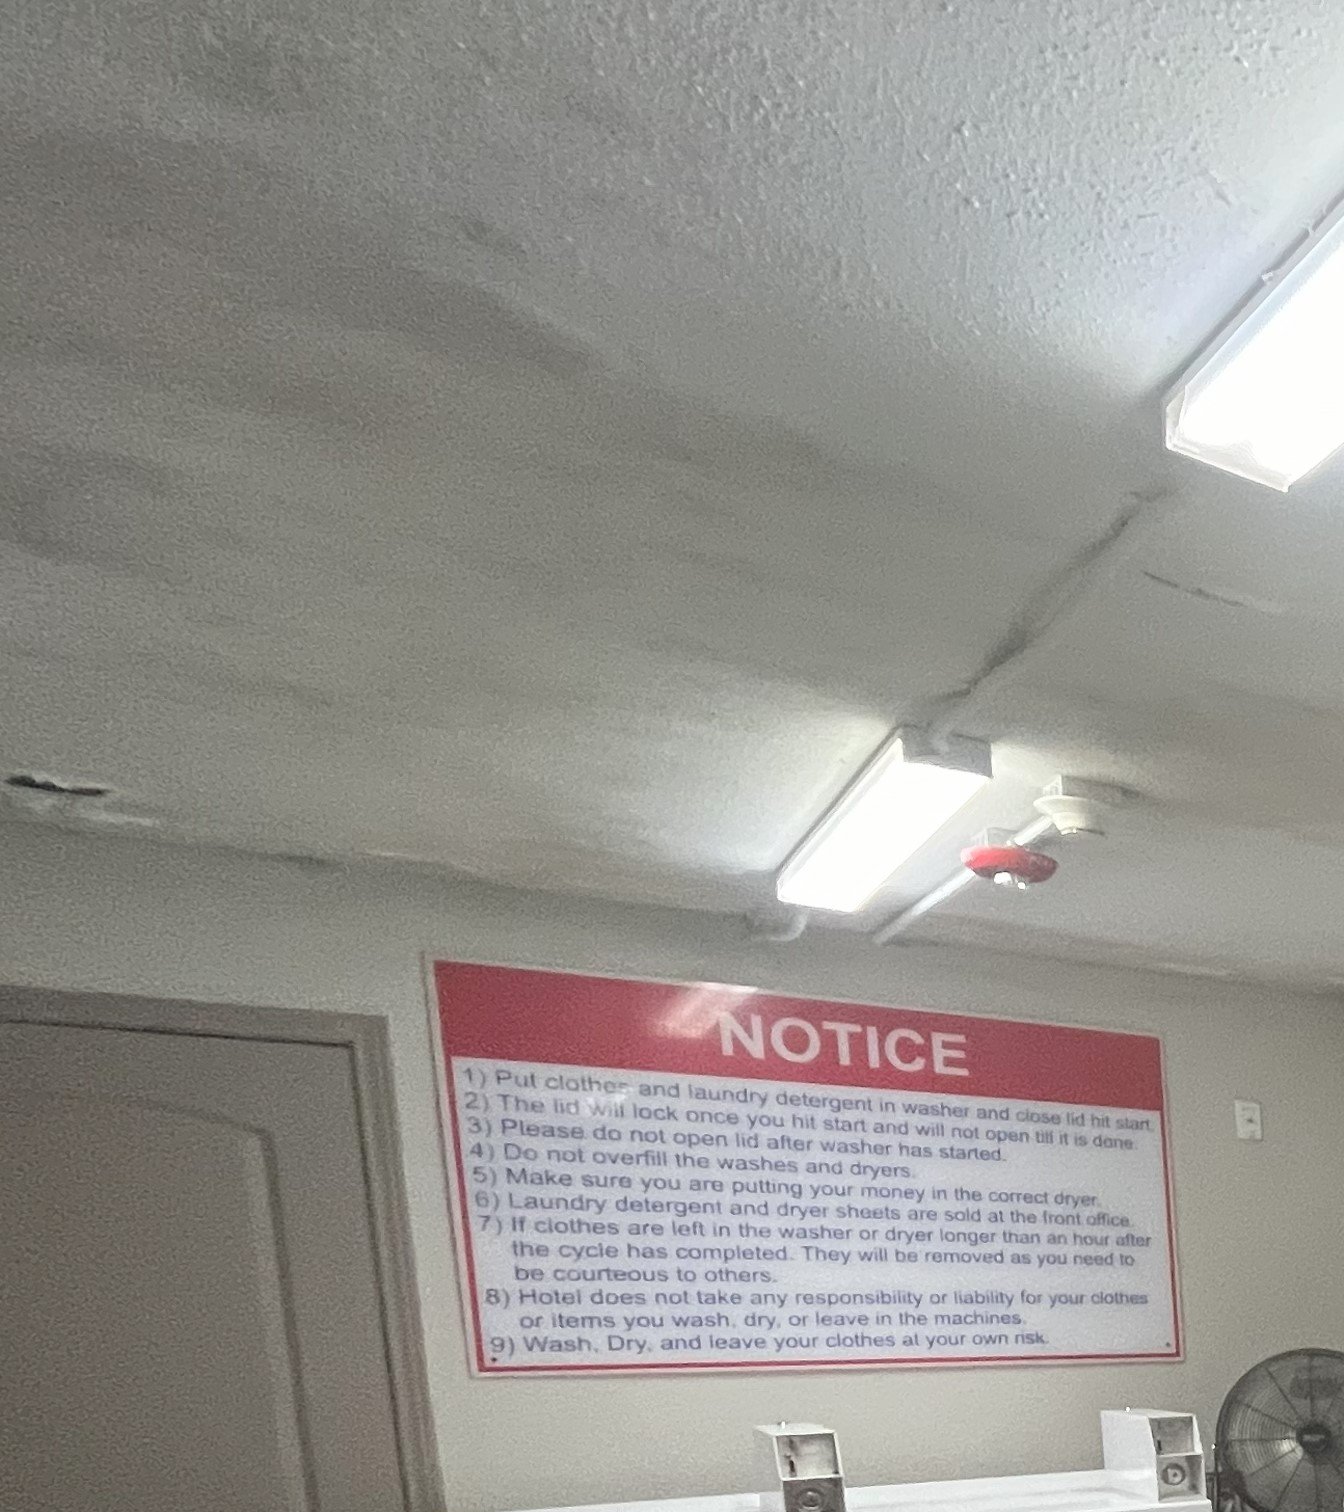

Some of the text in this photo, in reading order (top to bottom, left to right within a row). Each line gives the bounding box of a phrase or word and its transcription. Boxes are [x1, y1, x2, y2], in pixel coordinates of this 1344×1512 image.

[719, 1012, 971, 1077] NOTICE
[462, 1068, 488, 1088] 1)
[494, 1071, 537, 1089] Put
[637, 1081, 680, 1098] and
[687, 1085, 769, 1107] laundry
[774, 1091, 873, 1114] detergent
[878, 1099, 896, 1113] in
[901, 1100, 970, 1118] washer
[975, 1106, 1010, 1121] and
[1015, 1108, 1061, 1124] close
[1065, 1112, 1085, 1126] lid
[1090, 1114, 1110, 1127] hit
[463, 1093, 490, 1112] 2)
[496, 1095, 545, 1113] The
[552, 1099, 580, 1115] lid
[631, 1104, 678, 1121] lock
[684, 1110, 740, 1125] once
[745, 1114, 785, 1131] you
[791, 1114, 817, 1129] hit
[822, 1116, 867, 1132] start
[871, 1119, 909, 1135] and
[950, 1125, 979, 1139] not
[984, 1129, 1030, 1145] open
[1058, 1132, 1069, 1145] it
[1073, 1133, 1088, 1146] is
[466, 1118, 493, 1137] 3)
[499, 1120, 587, 1139] Please
[591, 1125, 622, 1141] do
[628, 1127, 667, 1144] not
[671, 1132, 729, 1150] open
[734, 1133, 760, 1148] lid
[765, 1135, 814, 1151] after
[819, 1138, 893, 1155] washer
[897, 1143, 933, 1157] has
[468, 1142, 496, 1161] 4)
[502, 1144, 539, 1161] Do
[545, 1146, 585, 1163] not
[591, 1149, 668, 1166] overfill
[674, 1153, 710, 1168] the
[716, 1155, 798, 1172] washes
[804, 1159, 843, 1174] and
[471, 1167, 497, 1186] 5)
[504, 1169, 573, 1186] Make
[580, 1175, 633, 1188] sure
[639, 1177, 681, 1193] you
[688, 1179, 724, 1192] are
[731, 1178, 803, 1198] putting
[809, 1184, 855, 1200] your
[860, 1186, 925, 1202] money
[931, 1187, 947, 1200] in
[953, 1187, 983, 1201] the
[987, 1189, 1050, 1204] correct
[473, 1192, 501, 1210] 6)
[507, 1193, 608, 1214] Laundry
[614, 1197, 722, 1217] detergent
[728, 1201, 769, 1216] and
[775, 1202, 830, 1220] dryer
[834, 1204, 901, 1220] sheets
[906, 1209, 937, 1221] are
[943, 1208, 981, 1222] sold
[986, 1210, 1004, 1223] at
[1009, 1210, 1037, 1224] the
[1041, 1211, 1083, 1225] front
[477, 1216, 1152, 1246] 7) If clothes are left in the washer or dryer longer than an hour after
[509, 1241, 551, 1257] the
[556, 1242, 619, 1261] cycle
[625, 1244, 668, 1258] has
[800, 1247, 852, 1264] They
[856, 1248, 888, 1262] will
[894, 1249, 922, 1262] be
[923, 1249, 1004, 1263] removed
[1010, 1253, 1032, 1264] as
[1036, 1254, 1068, 1267] you
[1072, 1252, 1114, 1265] need
[1119, 1253, 1135, 1265] to
[512, 1266, 545, 1280] be
[551, 1266, 669, 1281] courteous
[675, 1267, 697, 1282] to
[482, 1289, 1148, 1307] 8) Hotel does not take any responsibility or liability for your clothes
[518, 1316, 544, 1328] or
[550, 1313, 616, 1328] items
[622, 1316, 665, 1330] you
[787, 1315, 809, 1326] or
[814, 1312, 870, 1326] leave
[874, 1312, 892, 1325] in
[898, 1312, 928, 1325] the
[488, 1337, 516, 1355] 9)
[659, 1335, 702, 1350] and
[708, 1335, 767, 1349] leave
[773, 1337, 819, 1351] your
[824, 1333, 895, 1347] clothes
[900, 1333, 920, 1346] at
[925, 1335, 967, 1349] your
[971, 1334, 1009, 1345] own
